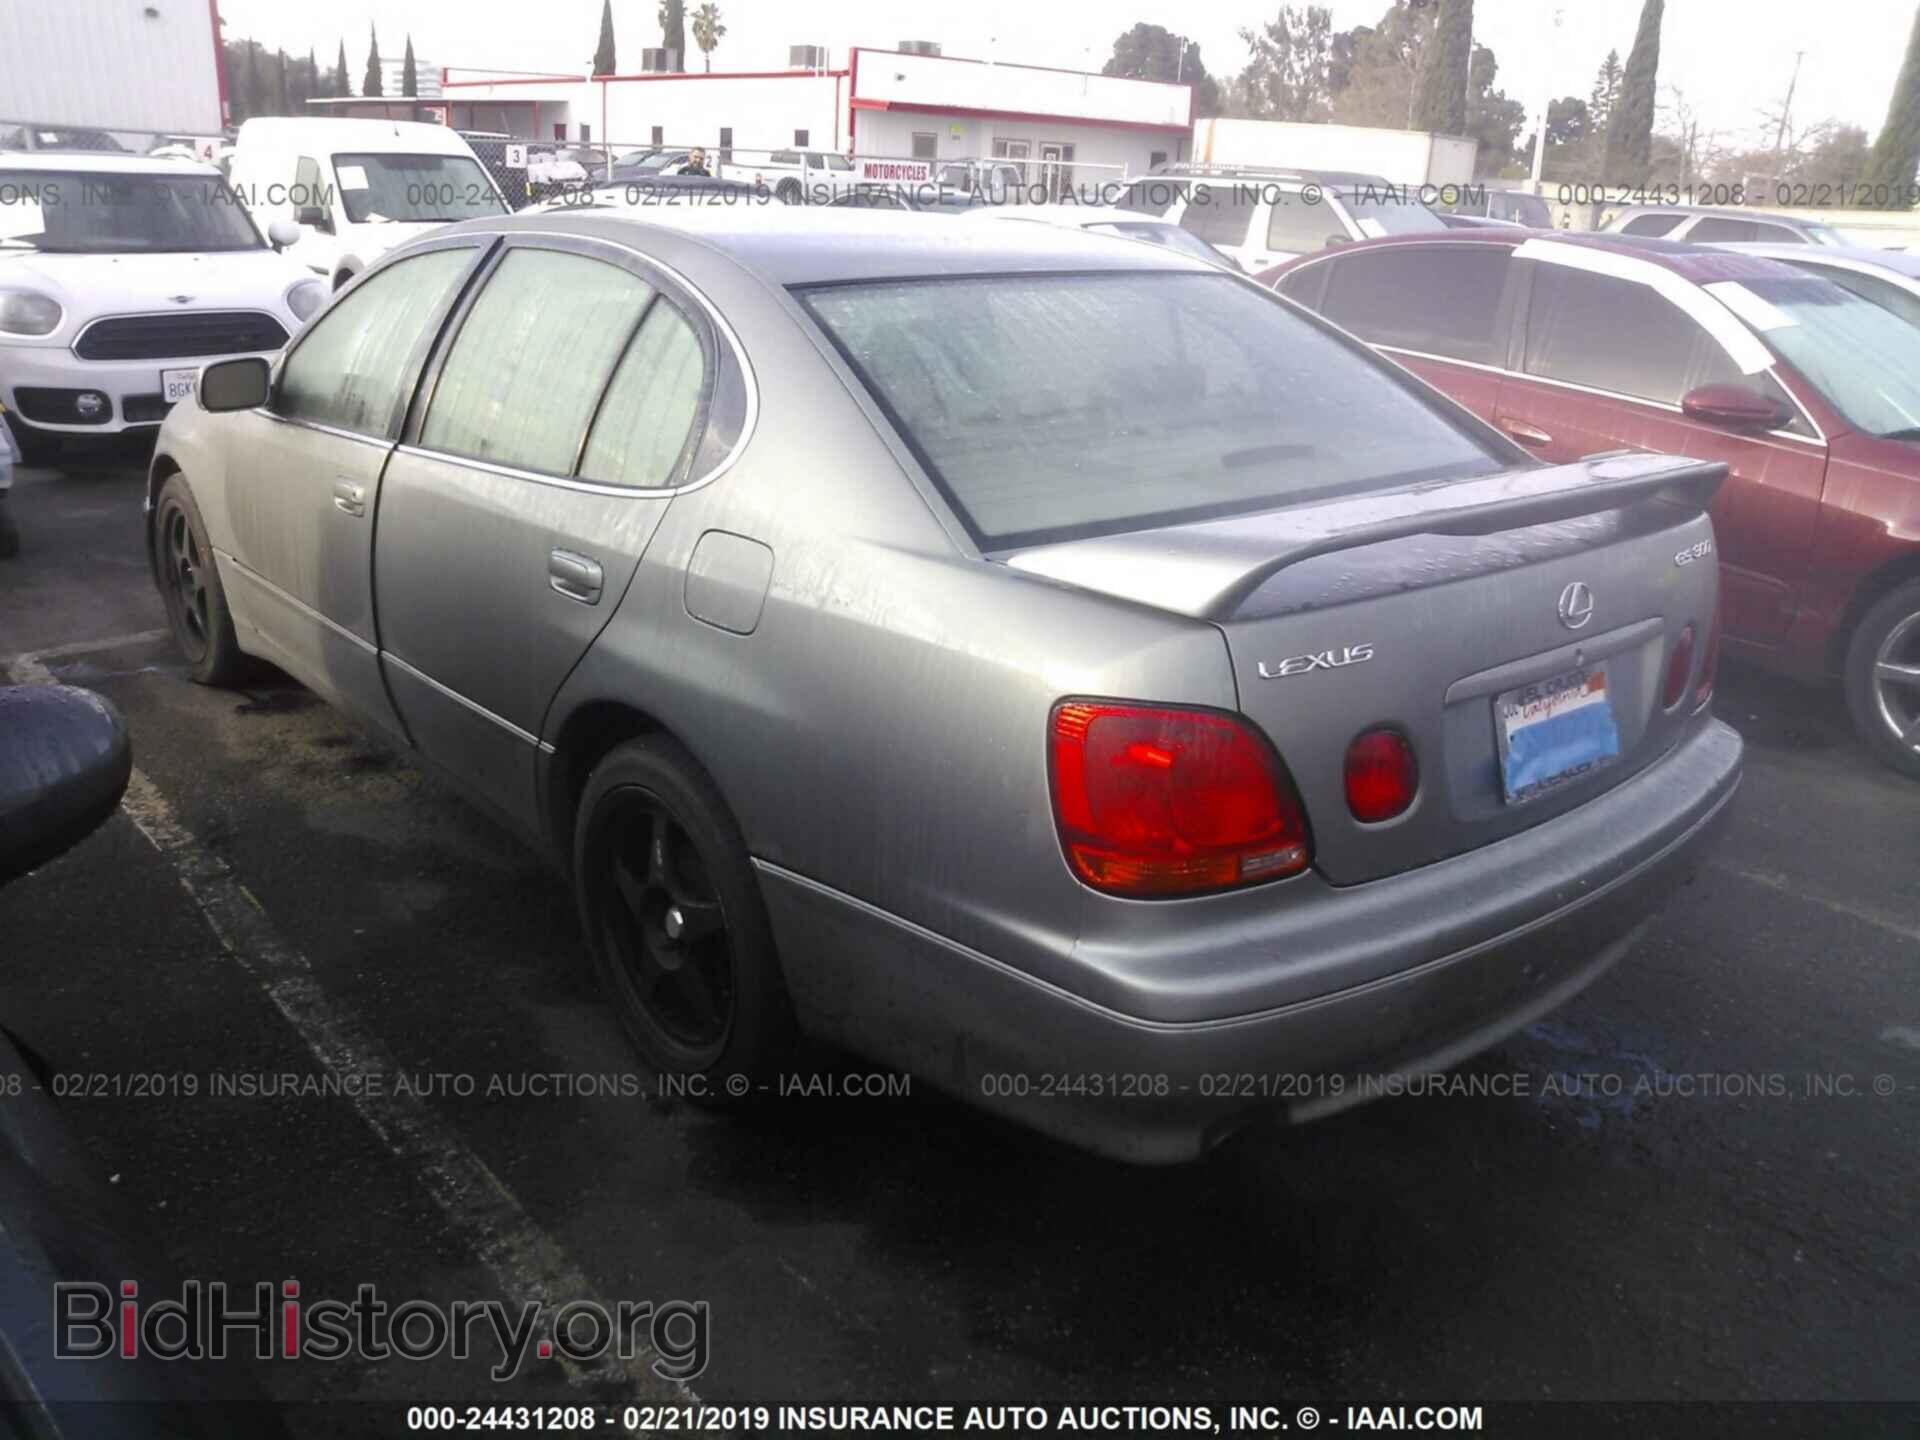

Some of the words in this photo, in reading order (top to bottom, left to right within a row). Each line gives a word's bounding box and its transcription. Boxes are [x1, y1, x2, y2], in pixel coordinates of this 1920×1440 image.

[203, 145, 212, 160] 4
[513, 150, 520, 163] 3
[864, 163, 927, 181] MOTORCYCLES
[1257, 642, 1374, 679] LEXUS
